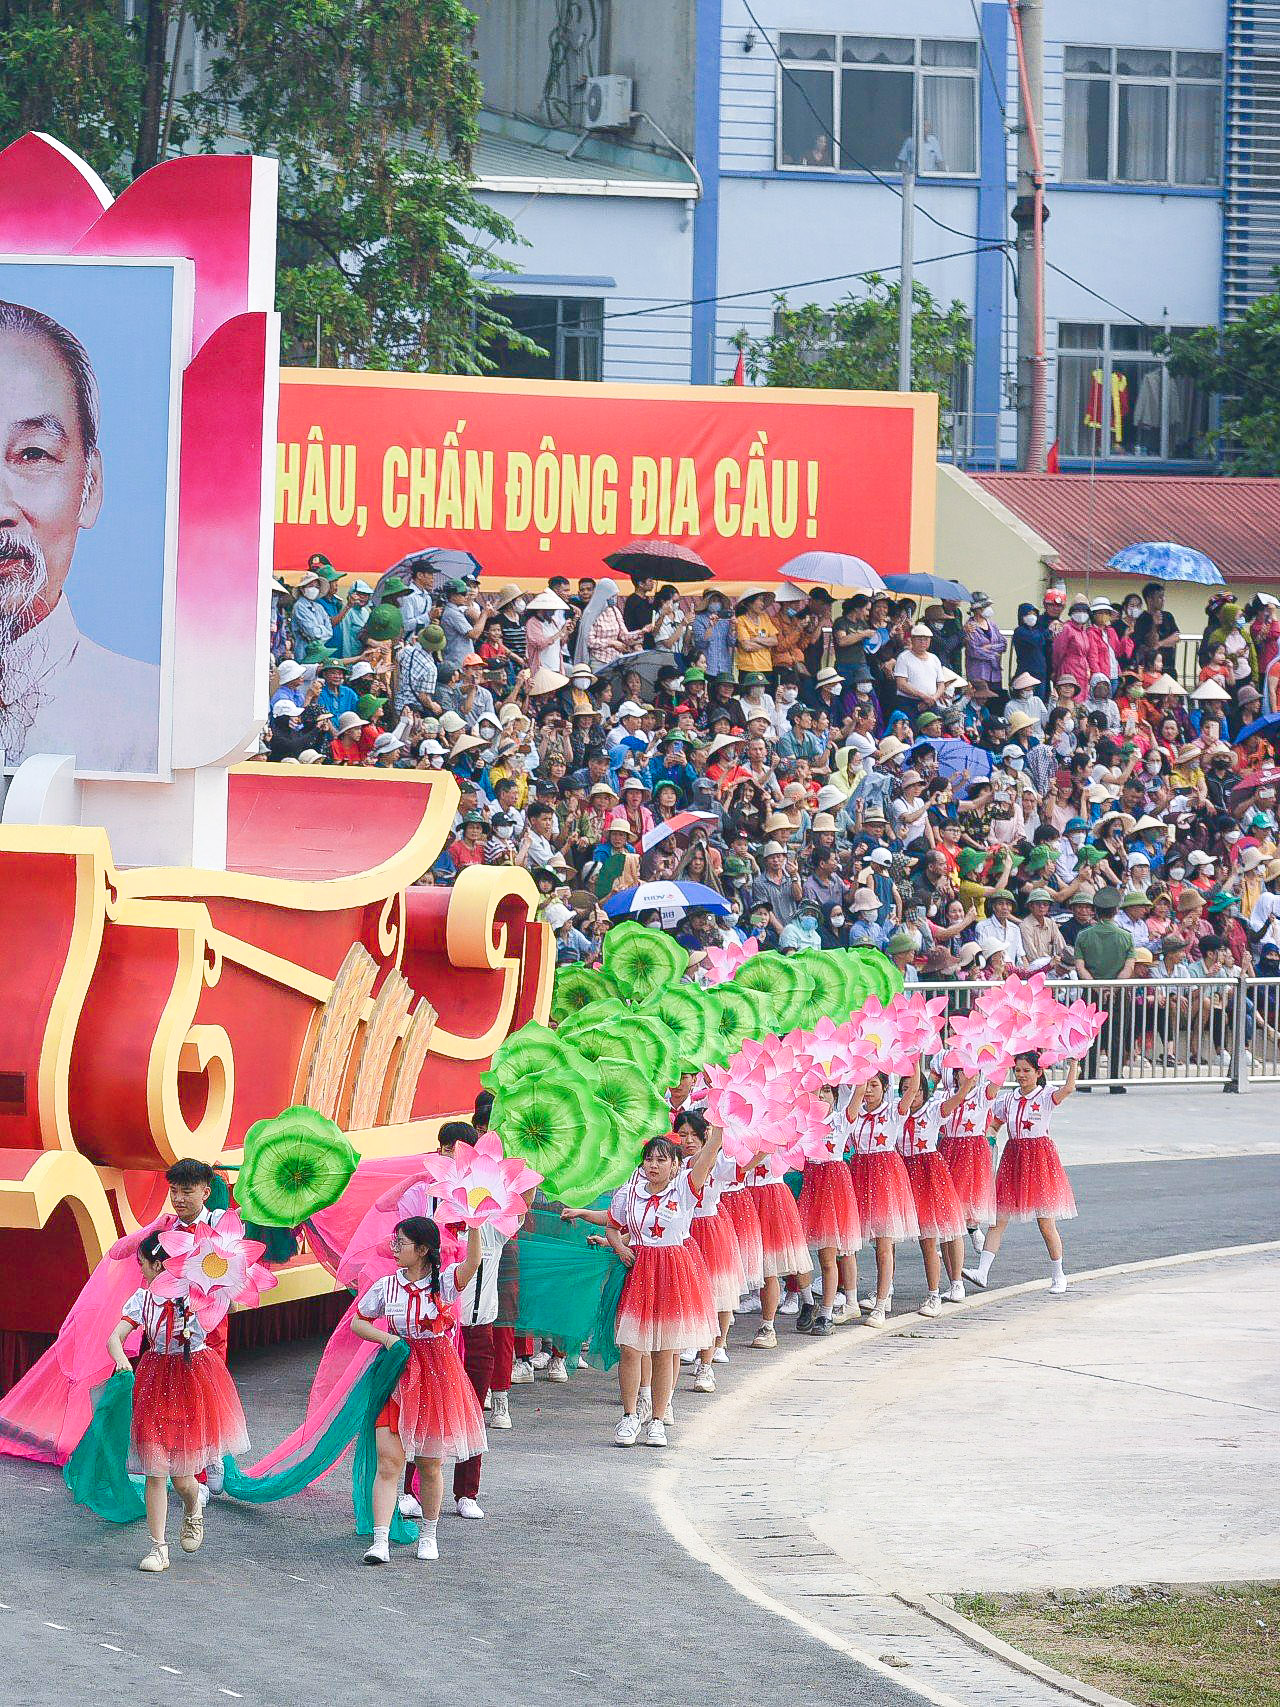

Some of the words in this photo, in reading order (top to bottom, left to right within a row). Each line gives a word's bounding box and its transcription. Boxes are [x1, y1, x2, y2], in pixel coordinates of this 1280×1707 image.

[273, 425, 368, 537] HÂU,
[381, 419, 494, 531] CHẤN
[504, 435, 619, 552] ĐỘNG
